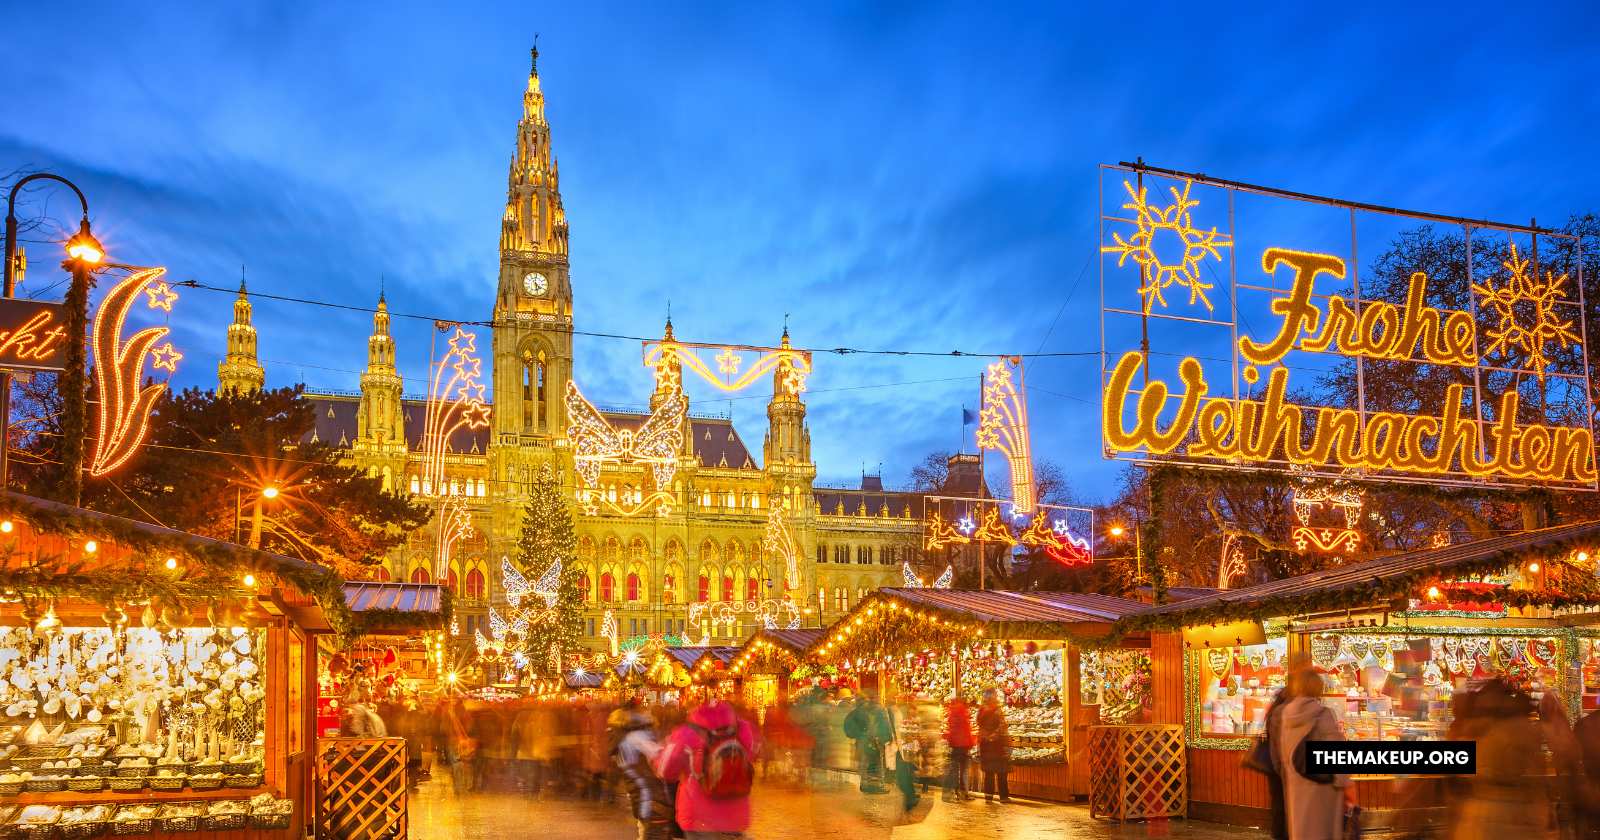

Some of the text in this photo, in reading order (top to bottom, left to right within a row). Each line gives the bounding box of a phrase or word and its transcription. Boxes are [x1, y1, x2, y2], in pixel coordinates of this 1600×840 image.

[0, 311, 67, 359] kt
[1238, 247, 1478, 366] Frohe
[1103, 351, 1599, 481] Weihnachten
